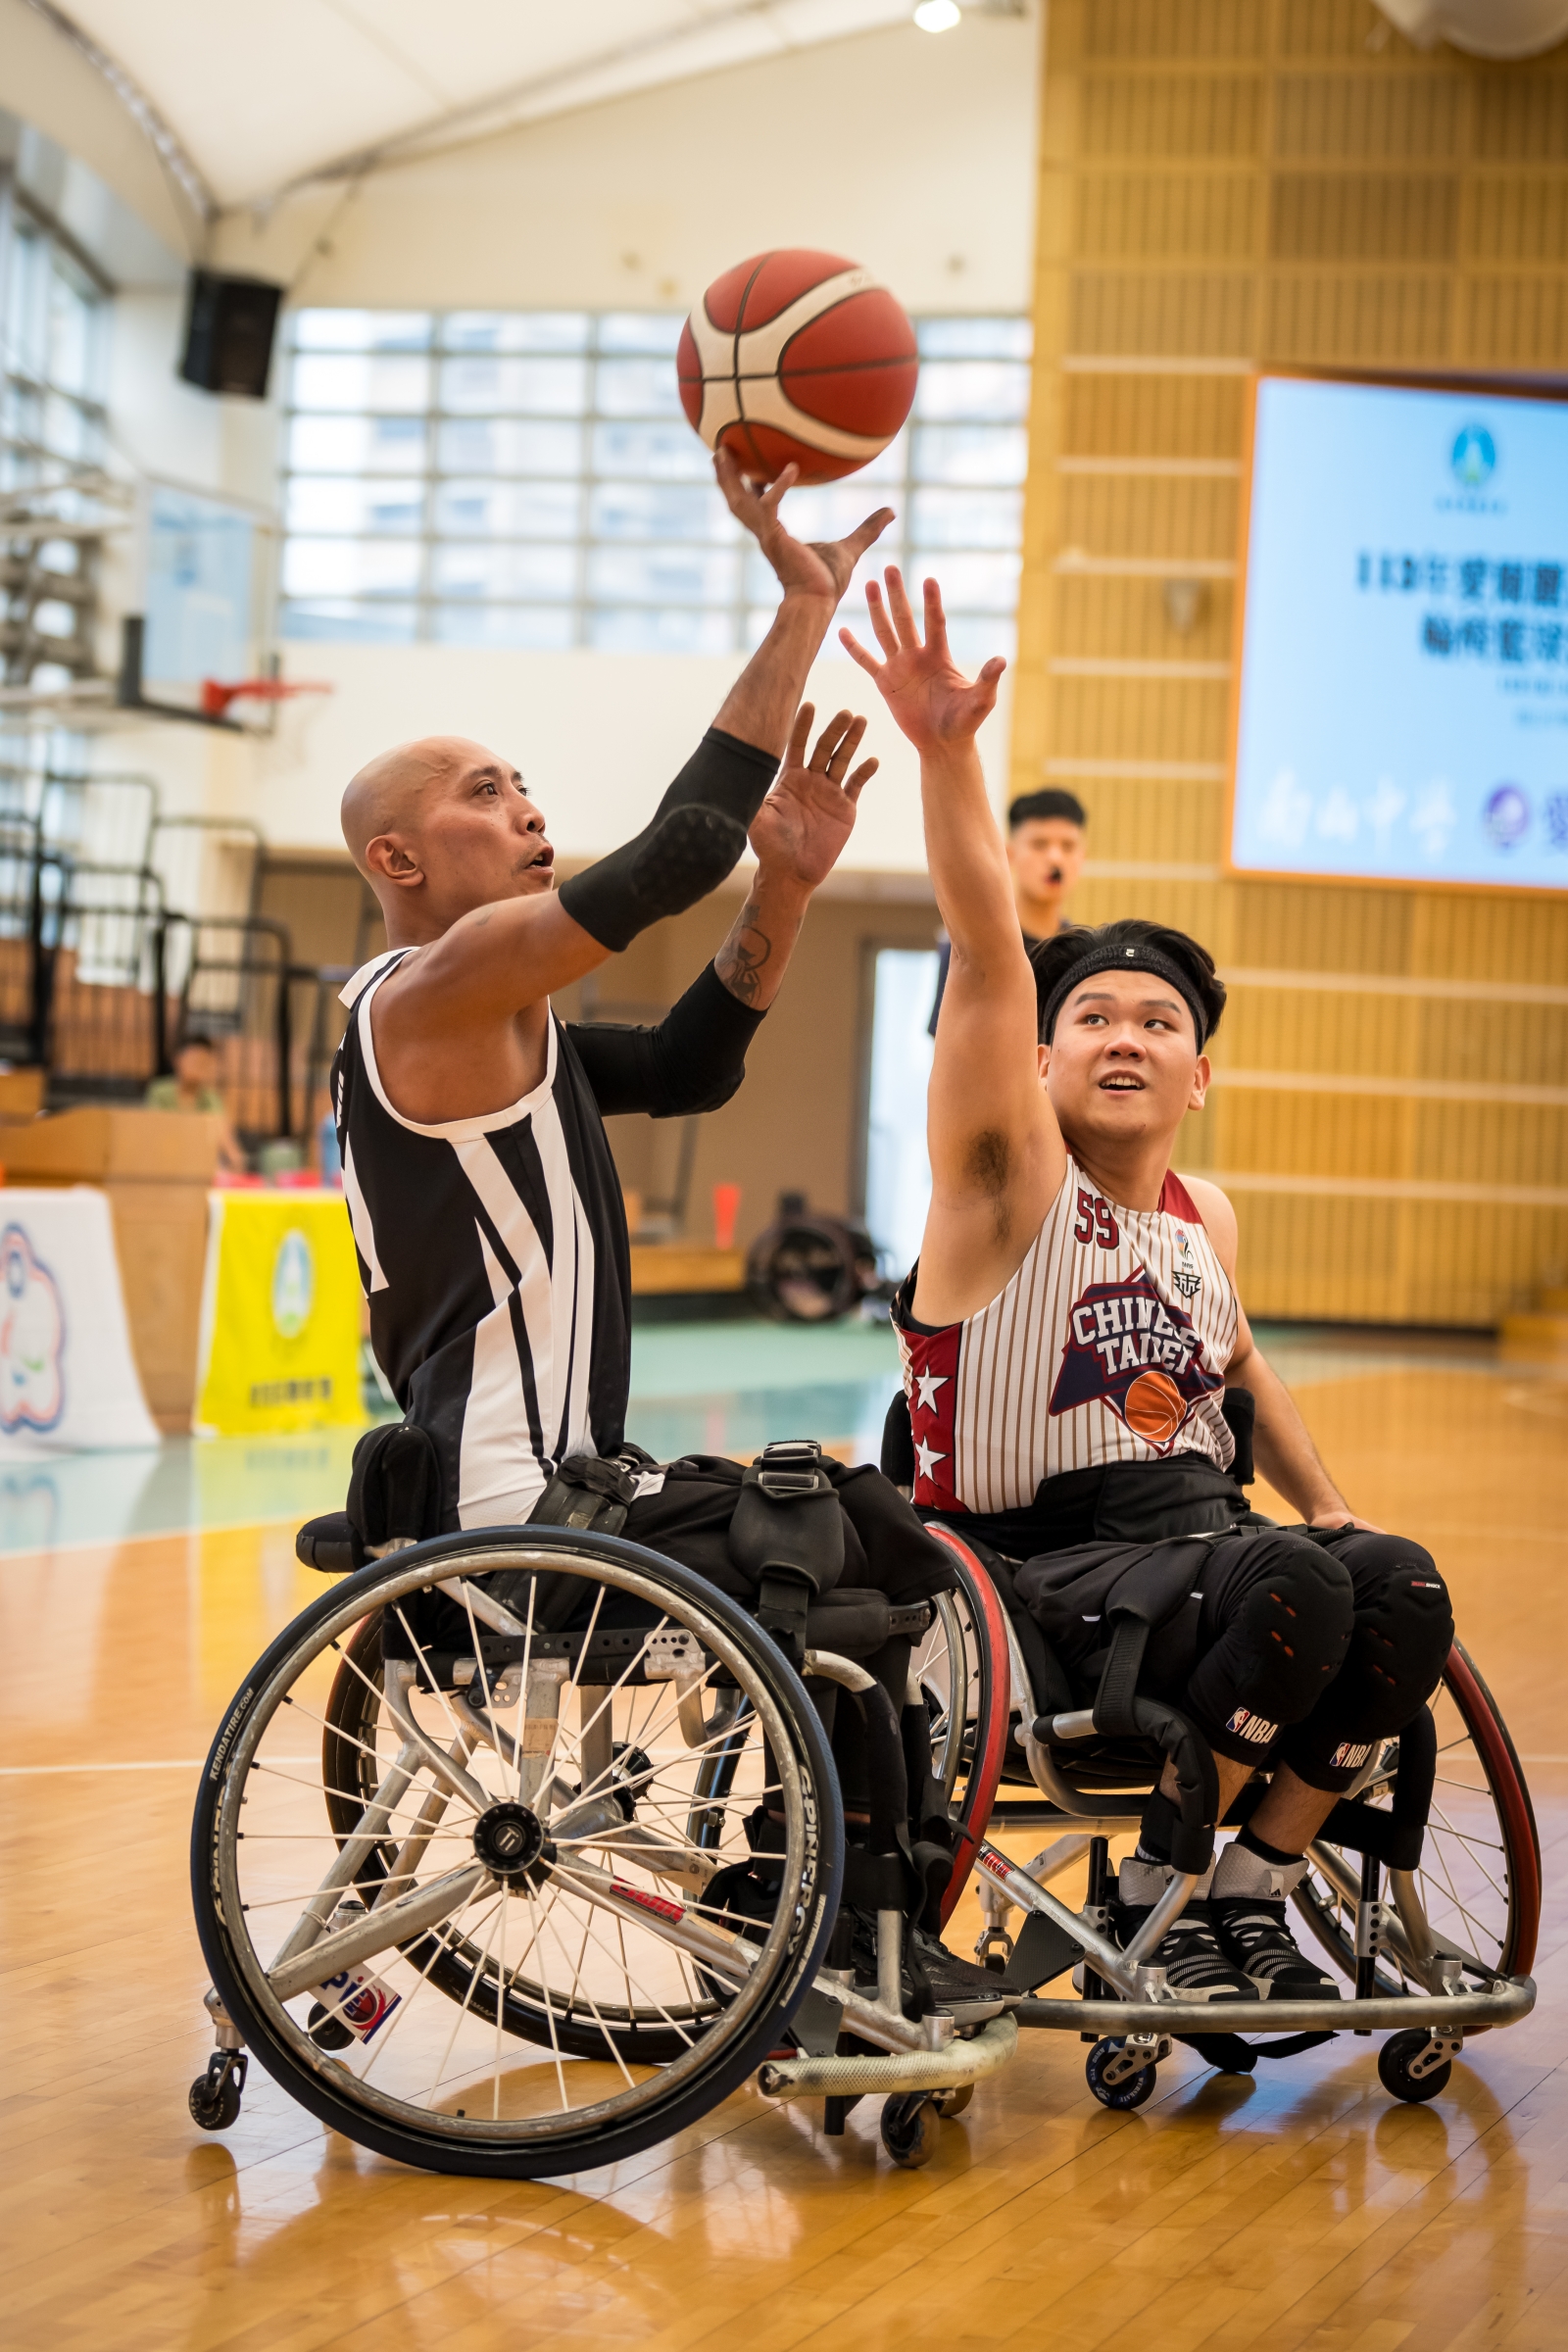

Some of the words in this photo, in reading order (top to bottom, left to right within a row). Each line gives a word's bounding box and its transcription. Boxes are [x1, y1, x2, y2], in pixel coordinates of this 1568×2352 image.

[1074, 1187, 1120, 1250] 59
[1072, 1297, 1201, 1348] CHINEE
[209, 1687, 255, 1781] KENDATIRE.COM
[1239, 1715, 1279, 1744] NBA
